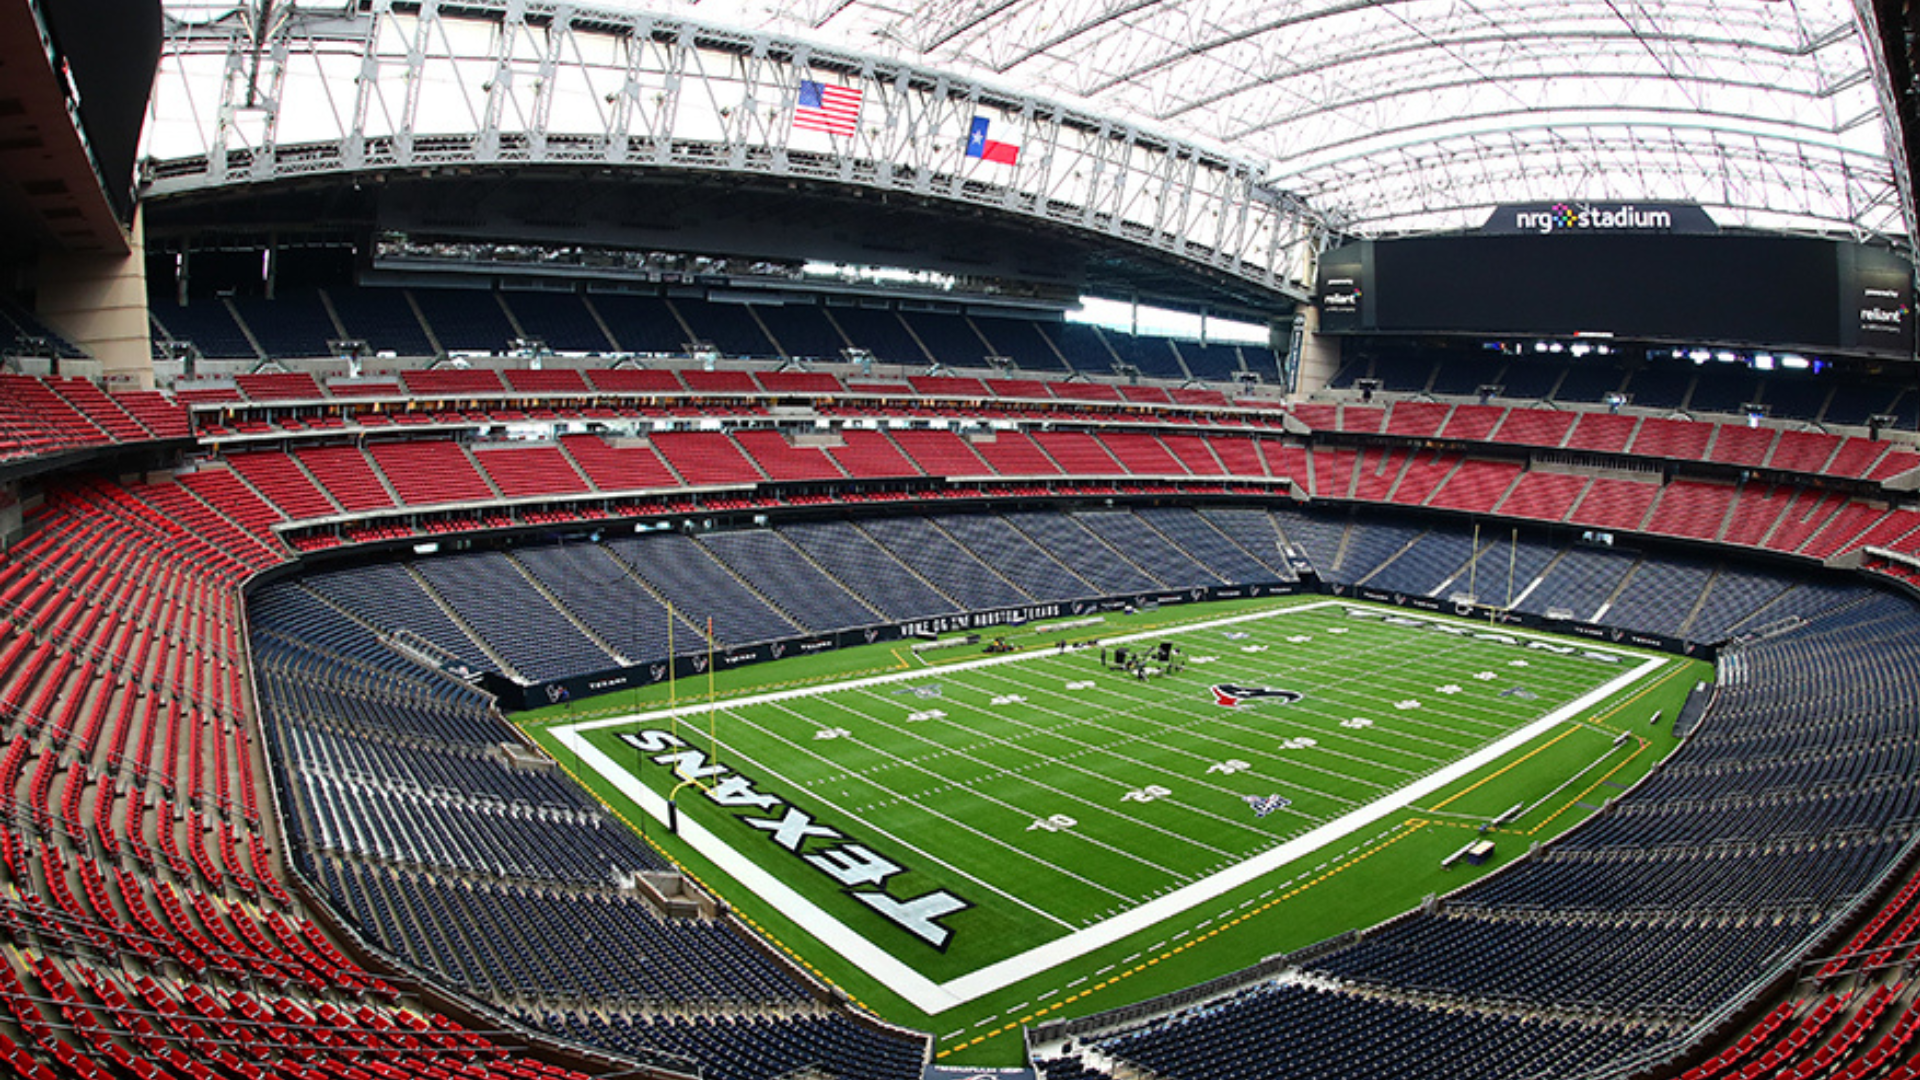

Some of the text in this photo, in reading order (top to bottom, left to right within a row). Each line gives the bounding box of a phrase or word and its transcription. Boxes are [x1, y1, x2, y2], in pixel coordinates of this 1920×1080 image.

[1516, 205, 1671, 233] nrg stadium
[1860, 308, 1901, 323] reliant
[1030, 813, 1078, 832] 10
[614, 729, 977, 953] TEXANS
